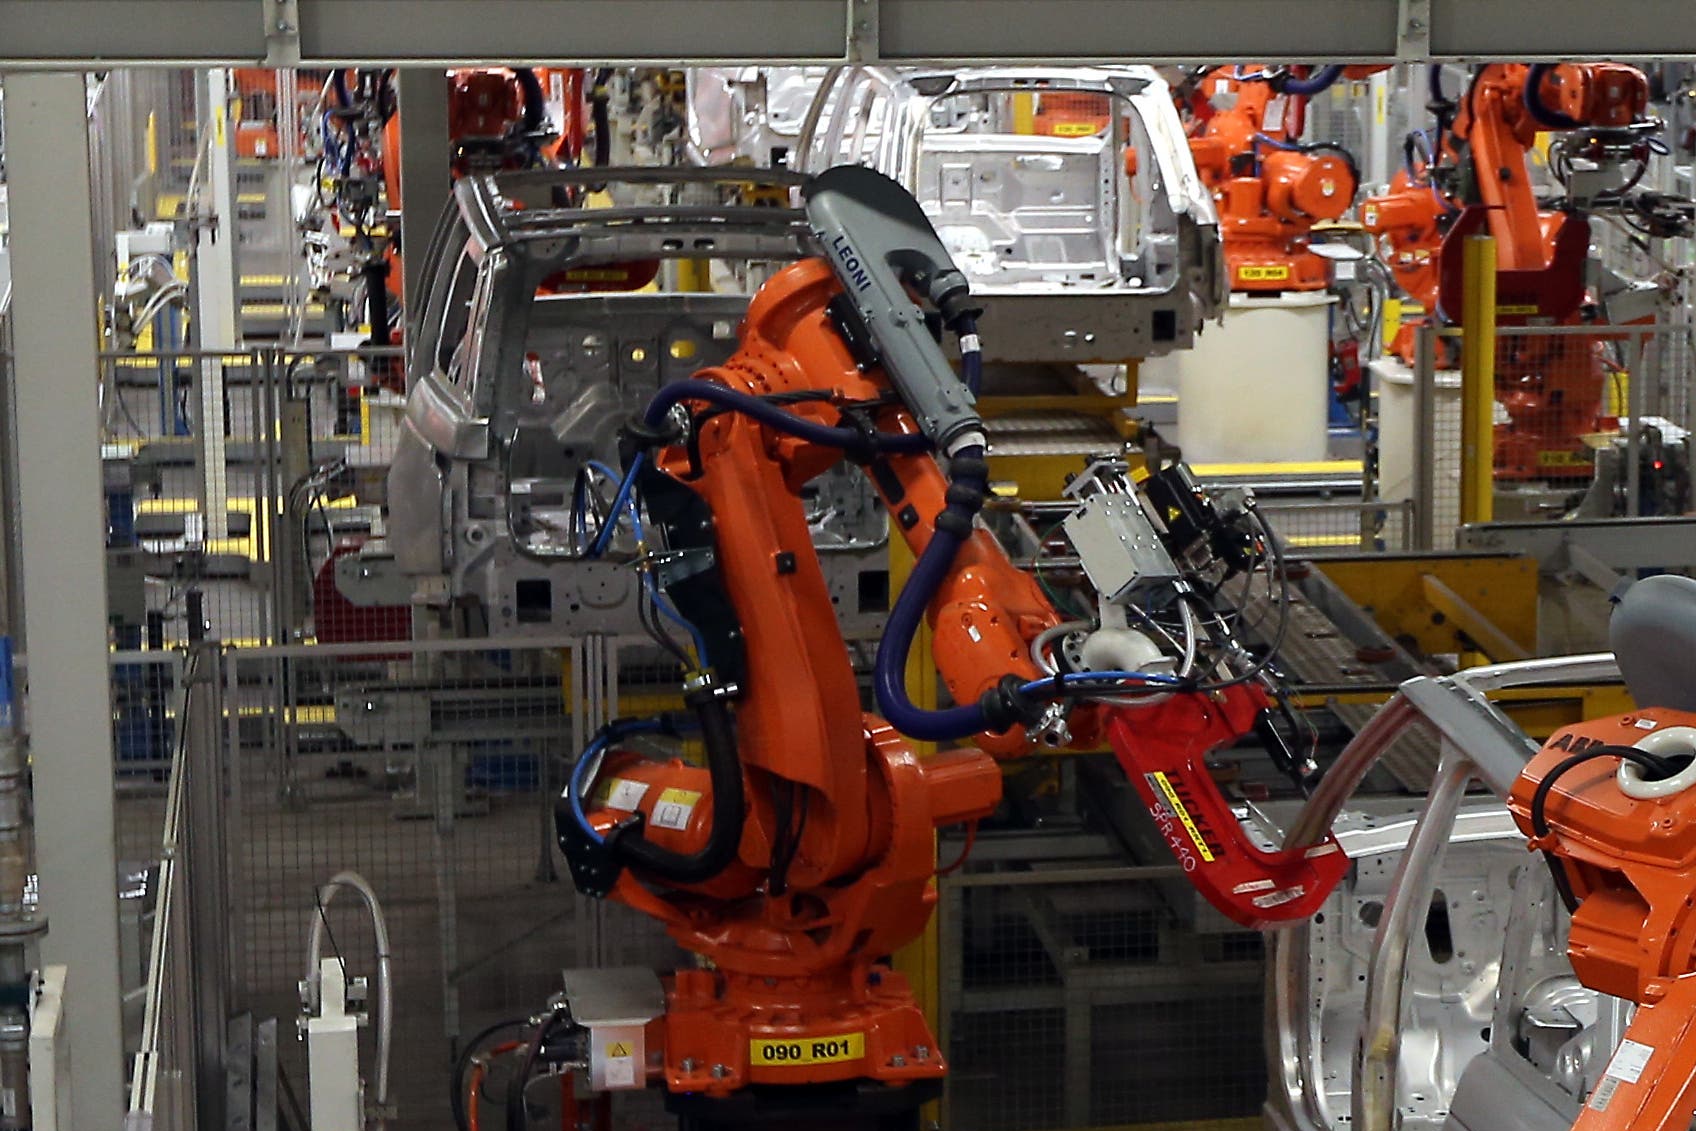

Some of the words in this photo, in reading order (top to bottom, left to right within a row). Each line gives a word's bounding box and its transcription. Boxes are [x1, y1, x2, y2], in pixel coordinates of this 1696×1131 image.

[832, 235, 872, 292] LEONI
[762, 1044, 802, 1060] 090
[811, 1039, 849, 1058] R01
